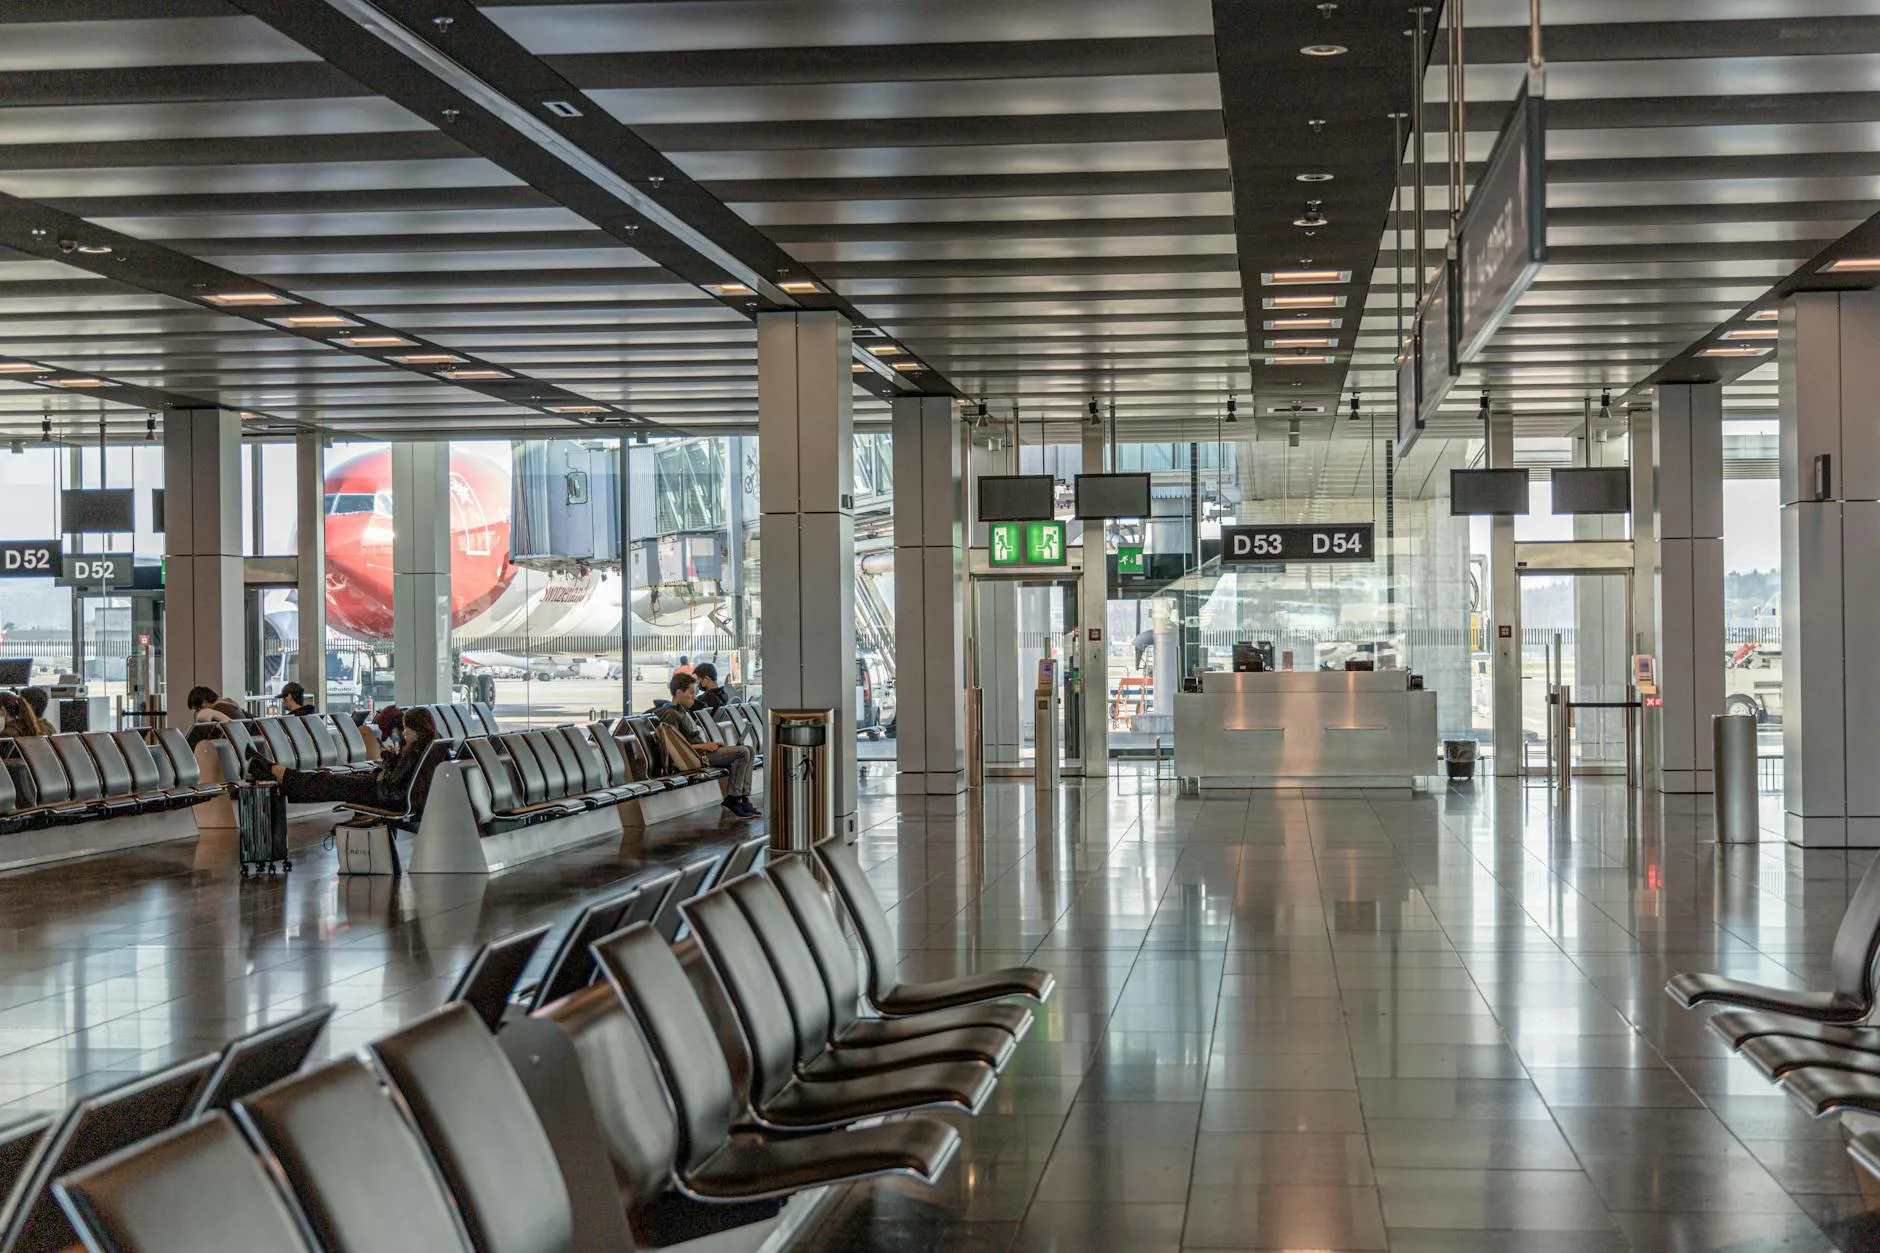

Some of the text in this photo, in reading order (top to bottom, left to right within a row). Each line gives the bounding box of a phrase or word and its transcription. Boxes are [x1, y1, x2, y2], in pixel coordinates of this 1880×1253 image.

[1233, 533, 1362, 555] D53 D54
[5, 549, 50, 569] D52
[75, 561, 115, 579] D52
